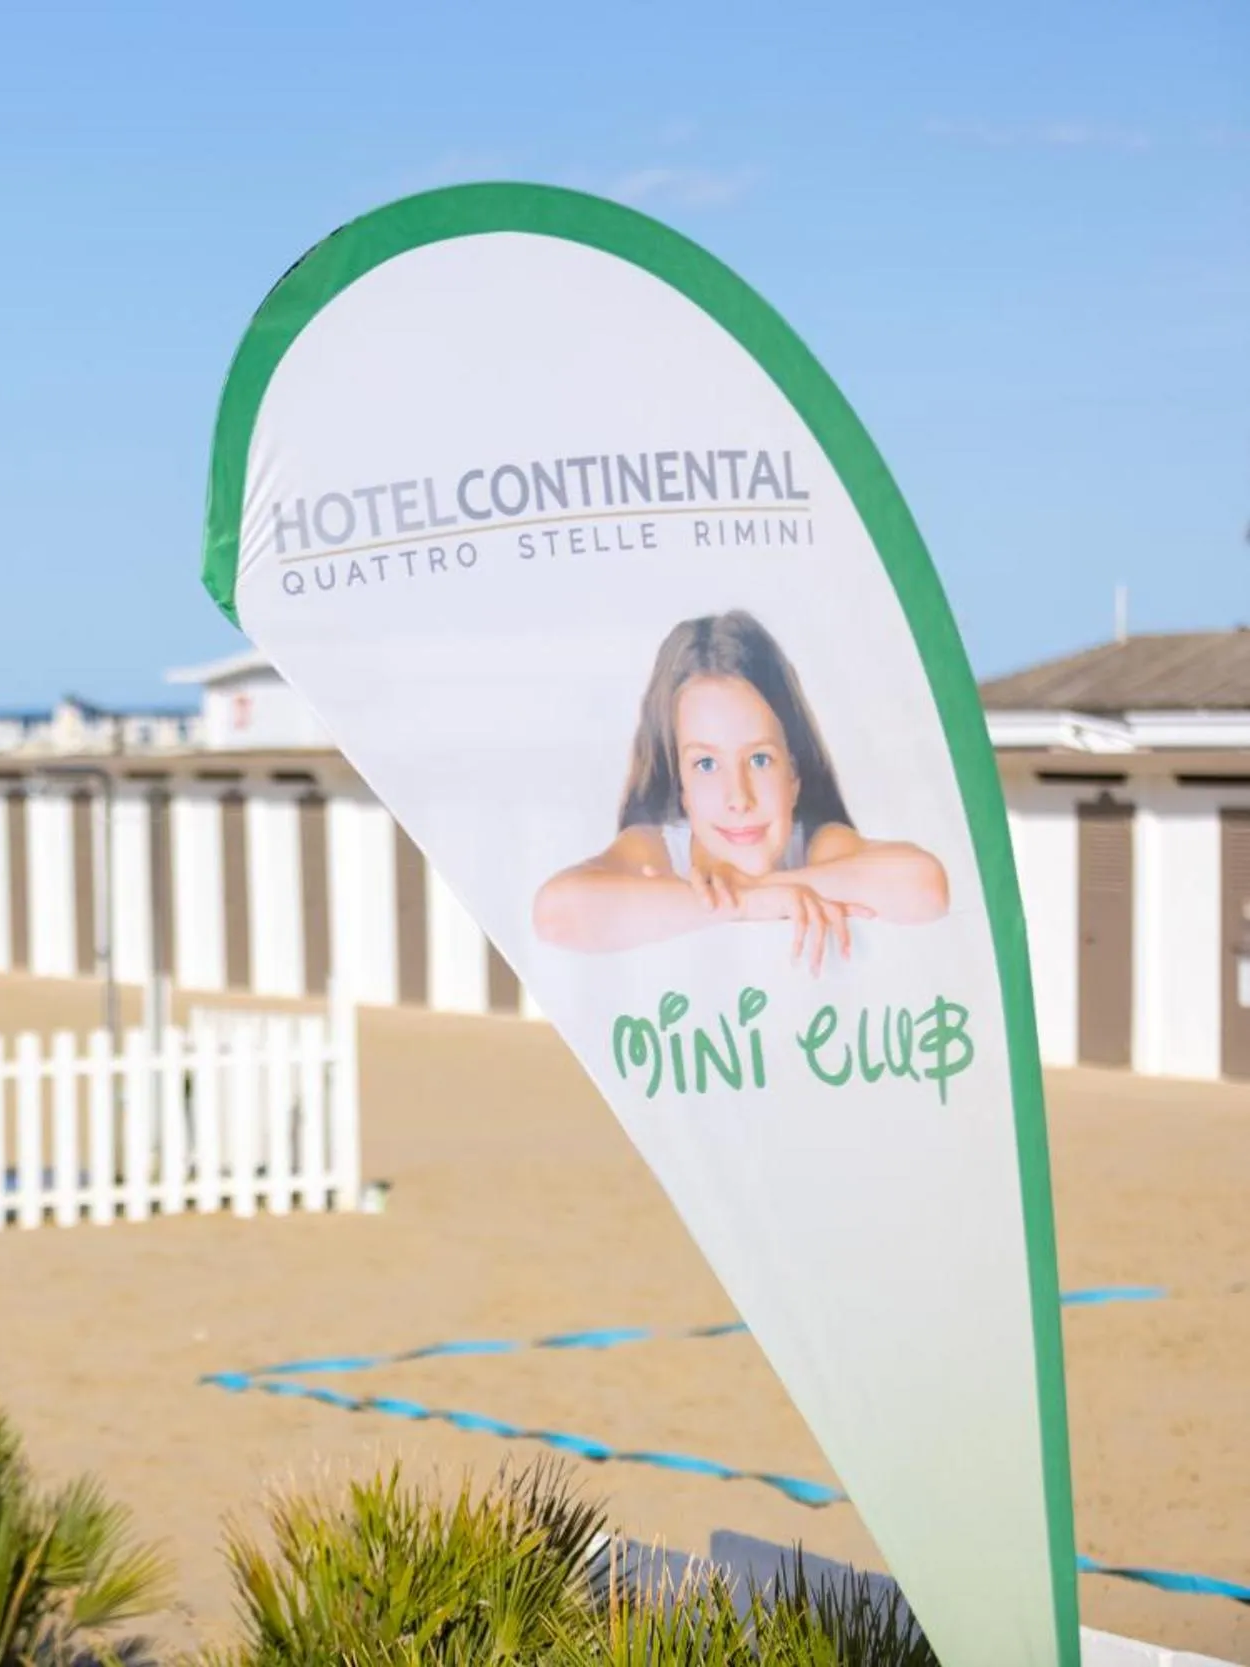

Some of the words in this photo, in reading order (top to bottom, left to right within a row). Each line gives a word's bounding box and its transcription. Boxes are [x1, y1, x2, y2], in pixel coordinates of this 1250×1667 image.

[281, 542, 478, 596] QUATTRO
[517, 521, 658, 559] STELLE
[694, 518, 815, 548] RIMINI
